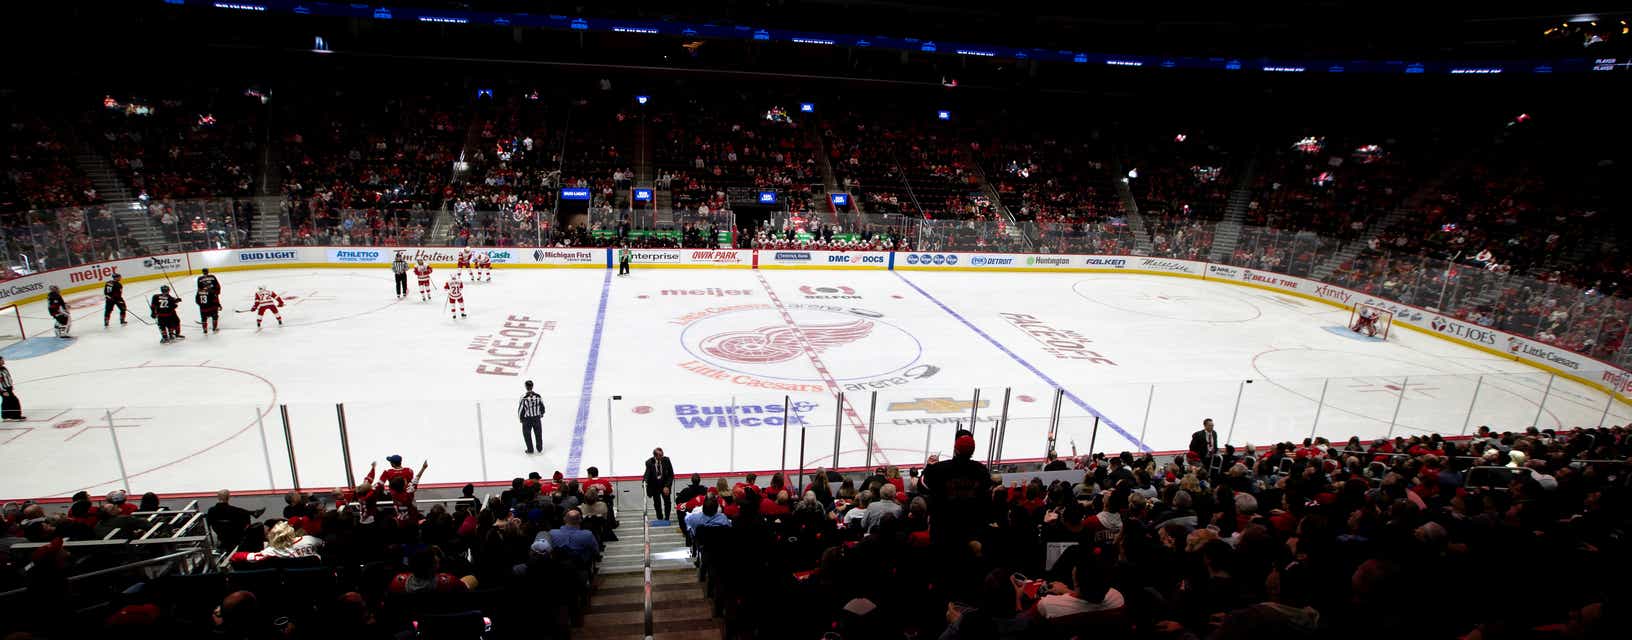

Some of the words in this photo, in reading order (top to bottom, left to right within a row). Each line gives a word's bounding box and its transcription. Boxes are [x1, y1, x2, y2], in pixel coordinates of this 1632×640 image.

[241, 252, 264, 261] BUD
[265, 250, 296, 259] LIGHT
[336, 250, 379, 258] ATHLETICO
[414, 249, 455, 262] Hortons
[488, 250, 511, 259] Cash
[545, 251, 576, 260] Michigan
[576, 251, 592, 259] First
[631, 252, 680, 262] nterprise
[691, 251, 714, 260] QWIK
[714, 251, 739, 260] PARK
[828, 255, 850, 263] DMC
[862, 255, 884, 263] DOCS
[987, 257, 1013, 265] DETROIT
[1035, 255, 1070, 266] Huntington
[1086, 258, 1127, 266] FALKEN
[70, 264, 118, 283] meijer
[1251, 274, 1278, 284] BELLE
[1279, 279, 1298, 289] TIRE
[10, 281, 44, 297] Caesars
[660, 287, 753, 297] meijer
[1314, 284, 1353, 303] xfinity
[200, 295, 208, 304] 13
[475, 314, 543, 376] FACE-OFF
[1522, 343, 1547, 360] Little
[1546, 351, 1580, 371] Caesars
[677, 359, 731, 382] Little
[730, 374, 825, 393] Caesars
[843, 376, 909, 391] arena
[1602, 370, 1632, 393] meije
[674, 403, 786, 416] Burns
